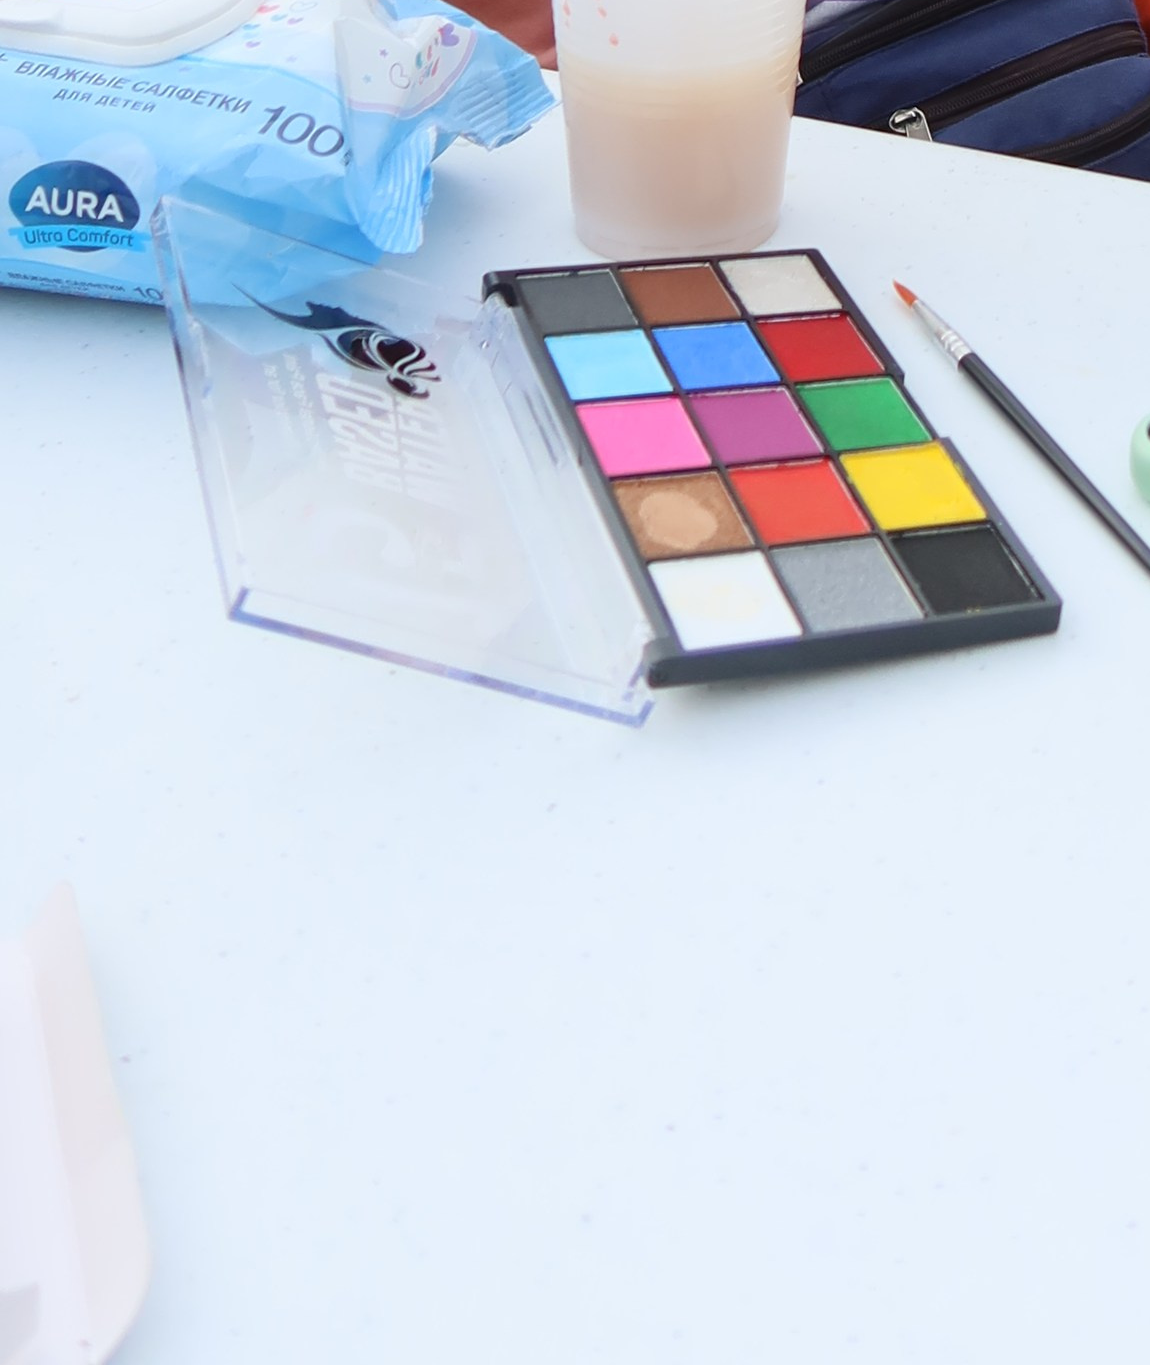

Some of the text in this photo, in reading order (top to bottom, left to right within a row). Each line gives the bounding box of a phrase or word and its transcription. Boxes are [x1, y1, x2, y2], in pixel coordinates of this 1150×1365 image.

[14, 60, 254, 115] ВЛАЖНЫЕ САЛФЕТКИ
[52, 88, 157, 114] ДЛЯ ДЕТЕЙ
[258, 104, 344, 157] 100
[24, 184, 125, 224] AURA
[24, 227, 135, 247] Ultra Comfort
[133, 285, 166, 303] 10
